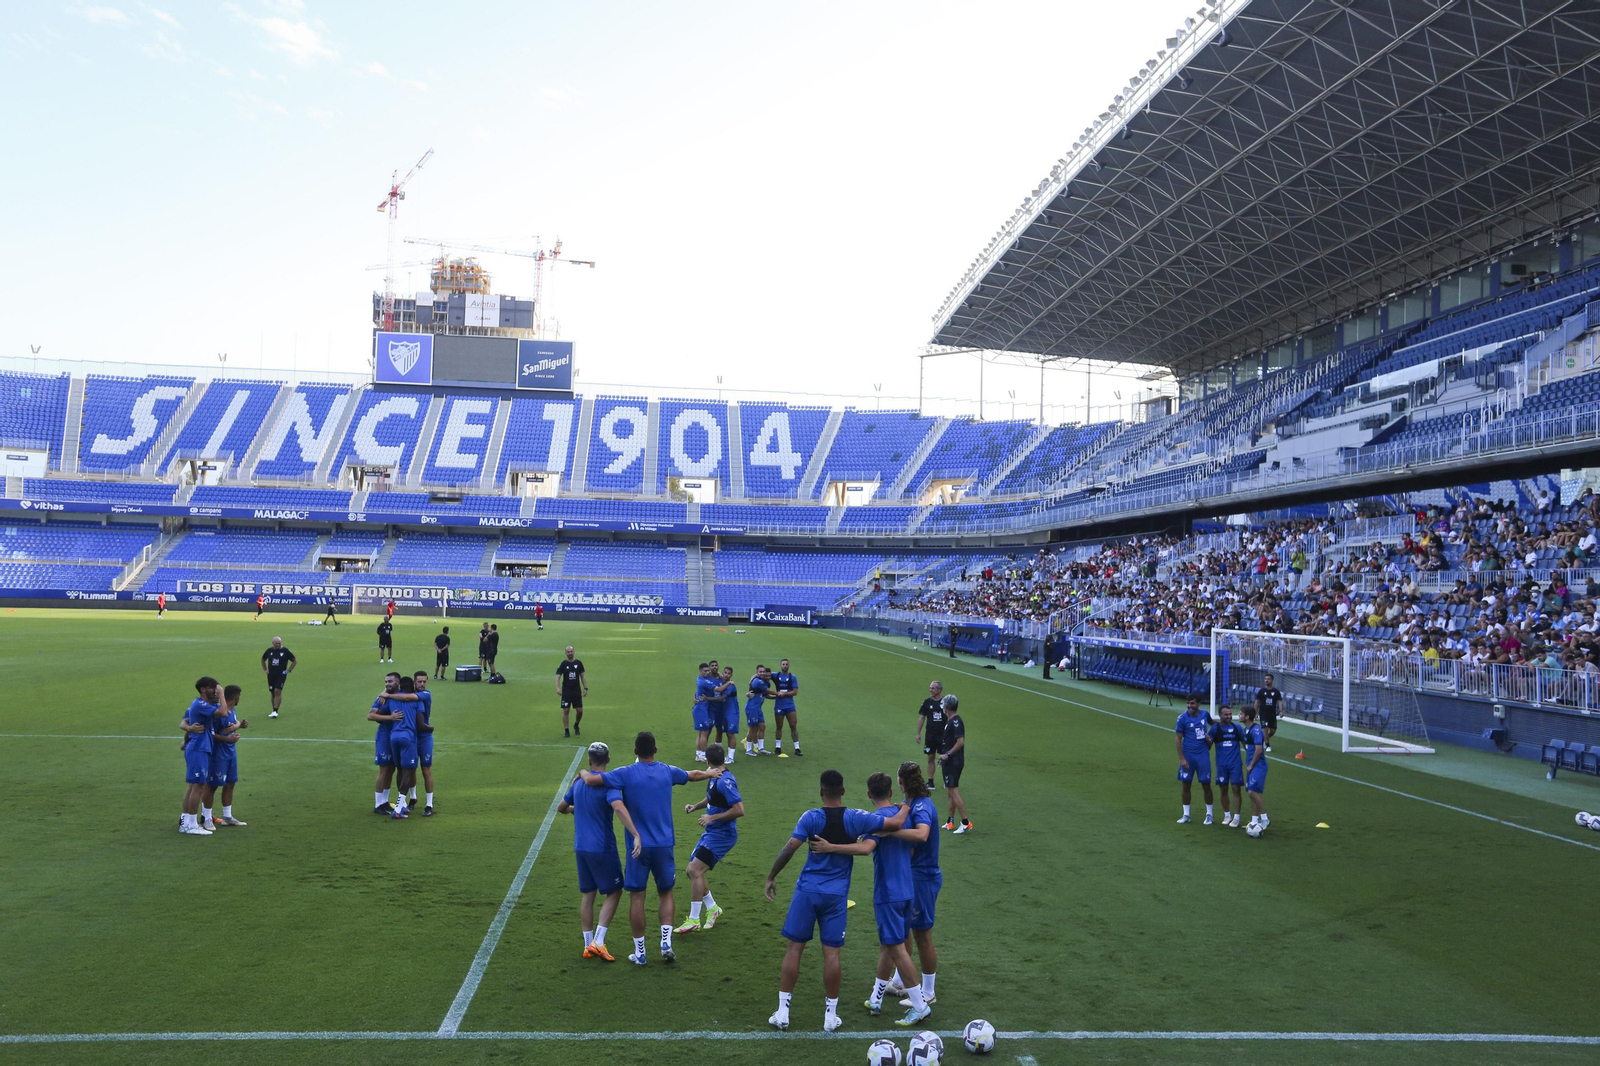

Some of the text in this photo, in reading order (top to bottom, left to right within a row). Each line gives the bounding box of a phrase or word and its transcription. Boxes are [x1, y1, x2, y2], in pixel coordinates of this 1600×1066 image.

[91, 386, 801, 480] SINCE 1904
[33, 502, 65, 511] vithas
[79, 591, 117, 600] hummel
[186, 582, 454, 600] LOS DE SIEMPRE FONDO SUR
[480, 590, 521, 602] 1904
[204, 595, 227, 603] Garum
[228, 596, 250, 604] Motor
[540, 592, 653, 606] MALAKAS
[687, 608, 722, 617] hummel
[767, 611, 806, 623] CaixaBank
